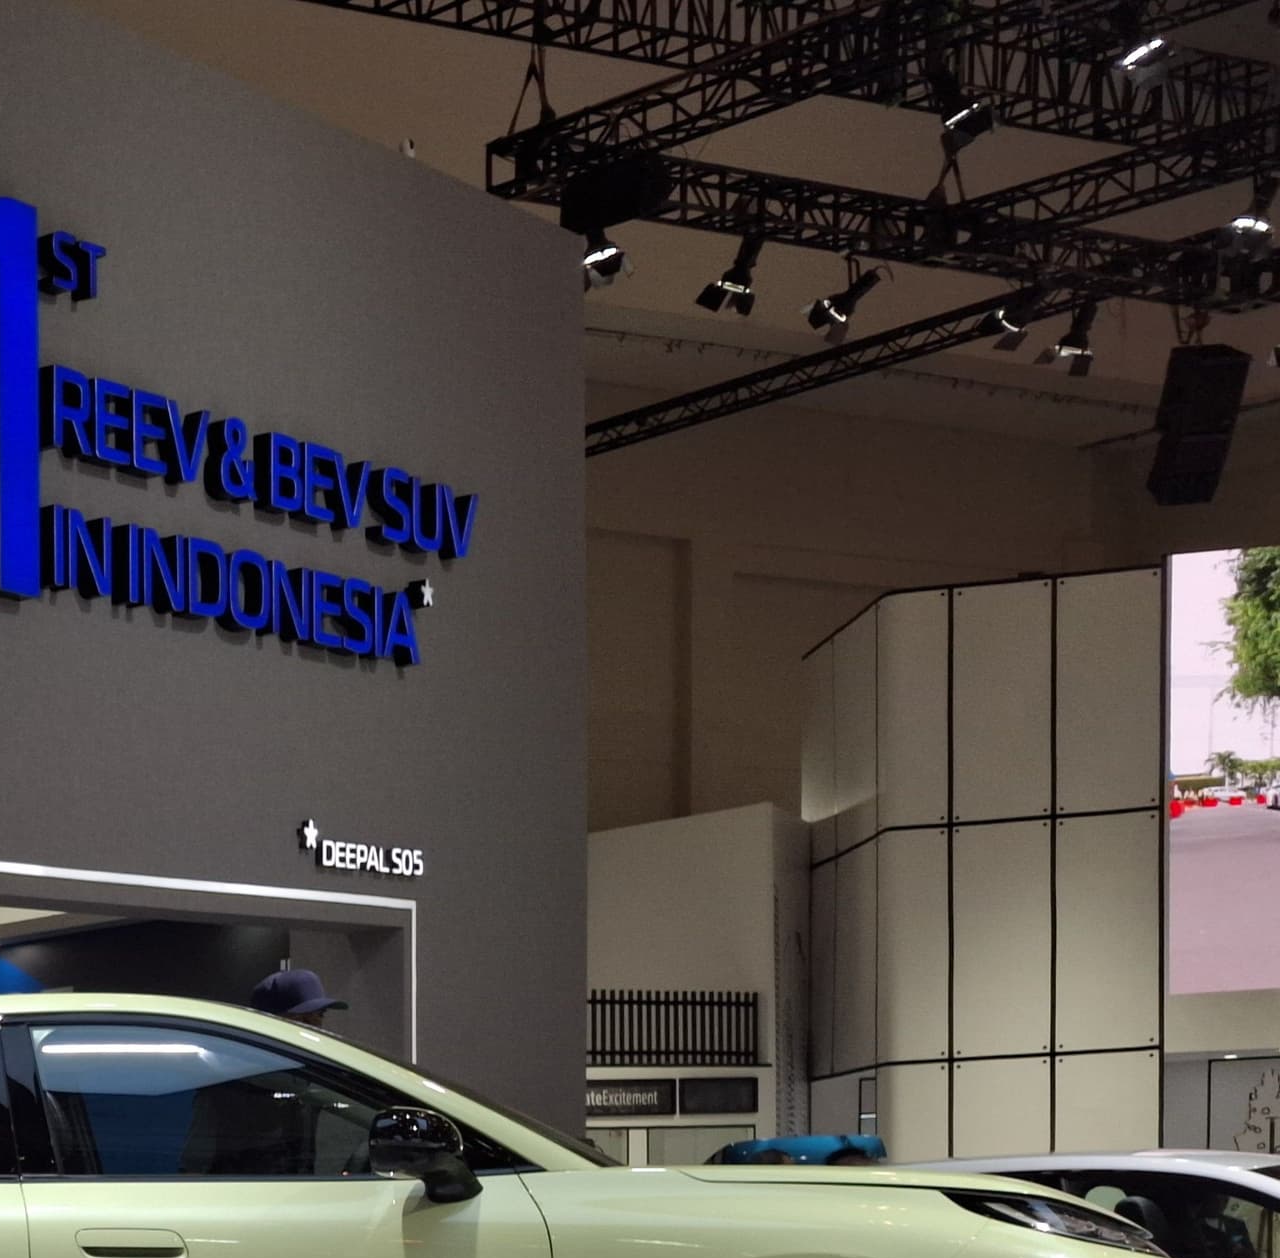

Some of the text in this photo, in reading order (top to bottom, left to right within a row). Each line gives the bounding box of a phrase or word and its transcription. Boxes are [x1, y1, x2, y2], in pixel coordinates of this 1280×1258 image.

[51, 364, 479, 558] REEV & BEV SUV
[52, 503, 112, 597] IN
[391, 847, 424, 877] S05
